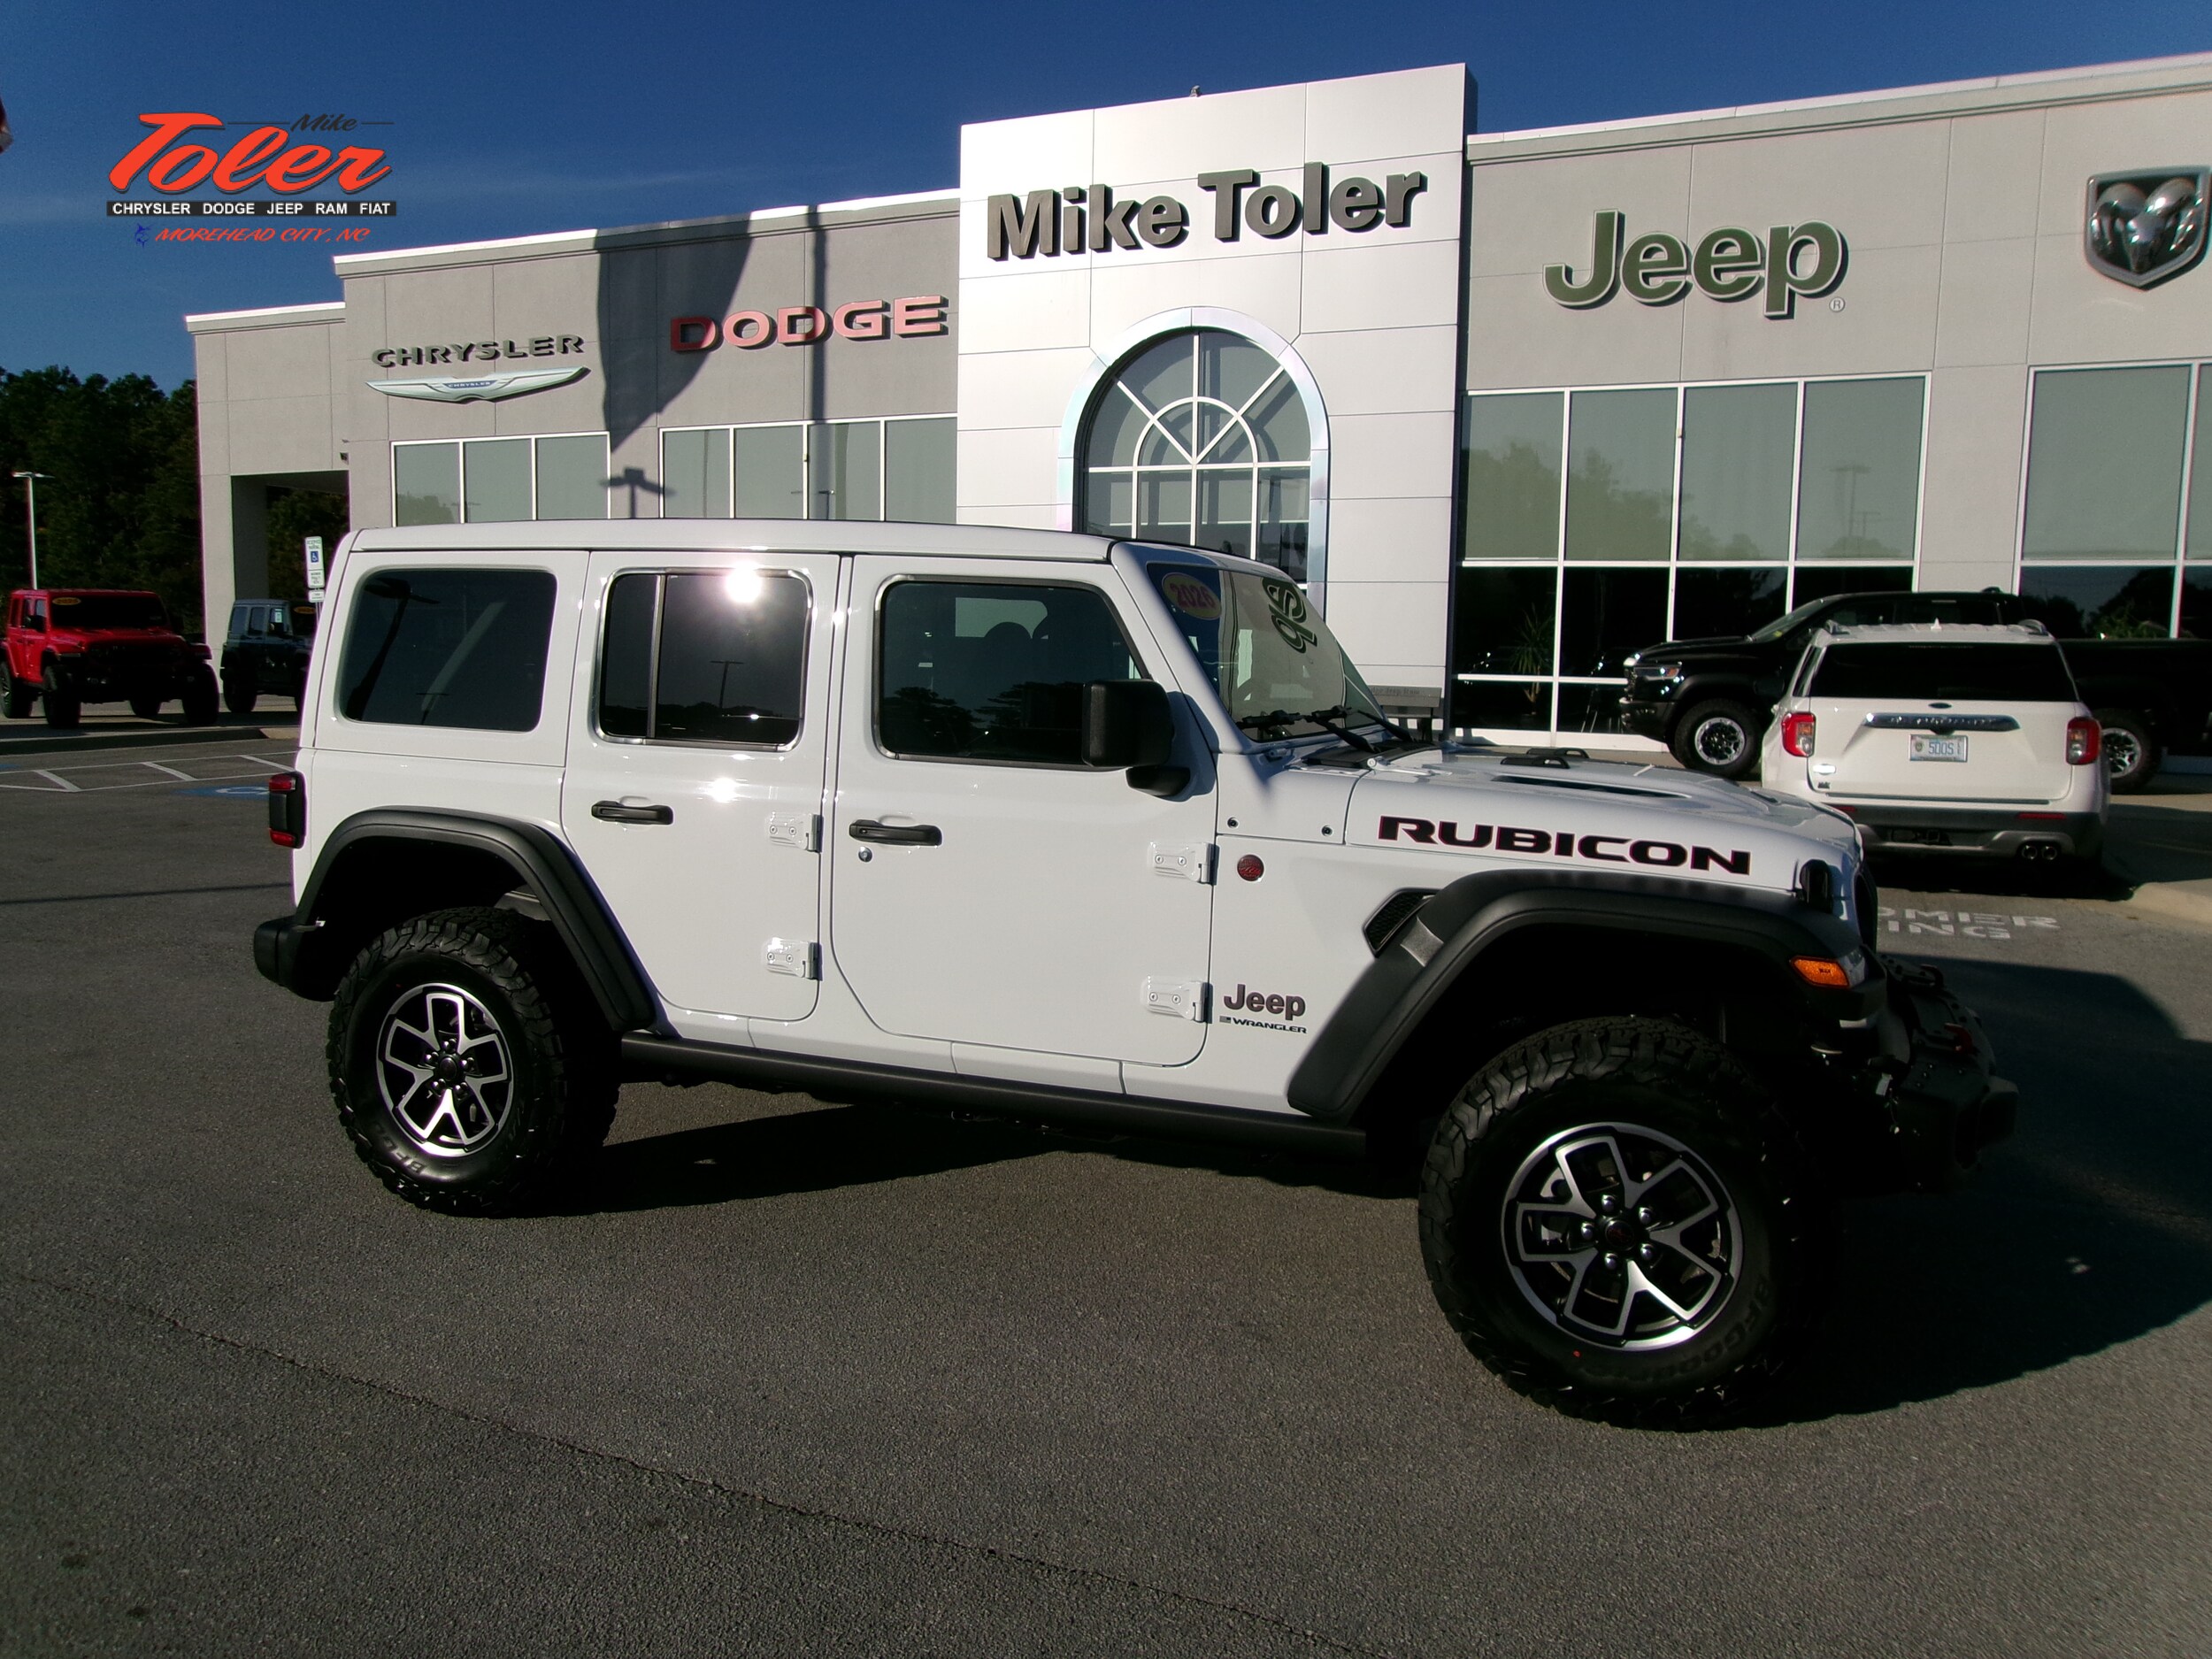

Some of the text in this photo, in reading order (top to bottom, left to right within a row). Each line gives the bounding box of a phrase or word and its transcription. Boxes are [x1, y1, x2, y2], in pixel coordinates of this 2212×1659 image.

[987, 161, 1428, 262] Mike Toler
[1542, 208, 1849, 320] Jeep
[668, 295, 949, 353] DODGE
[371, 334, 585, 368] CHRYSLER
[1170, 581, 1217, 609] 2026
[1378, 815, 1751, 875] RUBICON
[1224, 983, 1306, 1021] Jeep
[1233, 1017, 1307, 1034] WRANGLER
